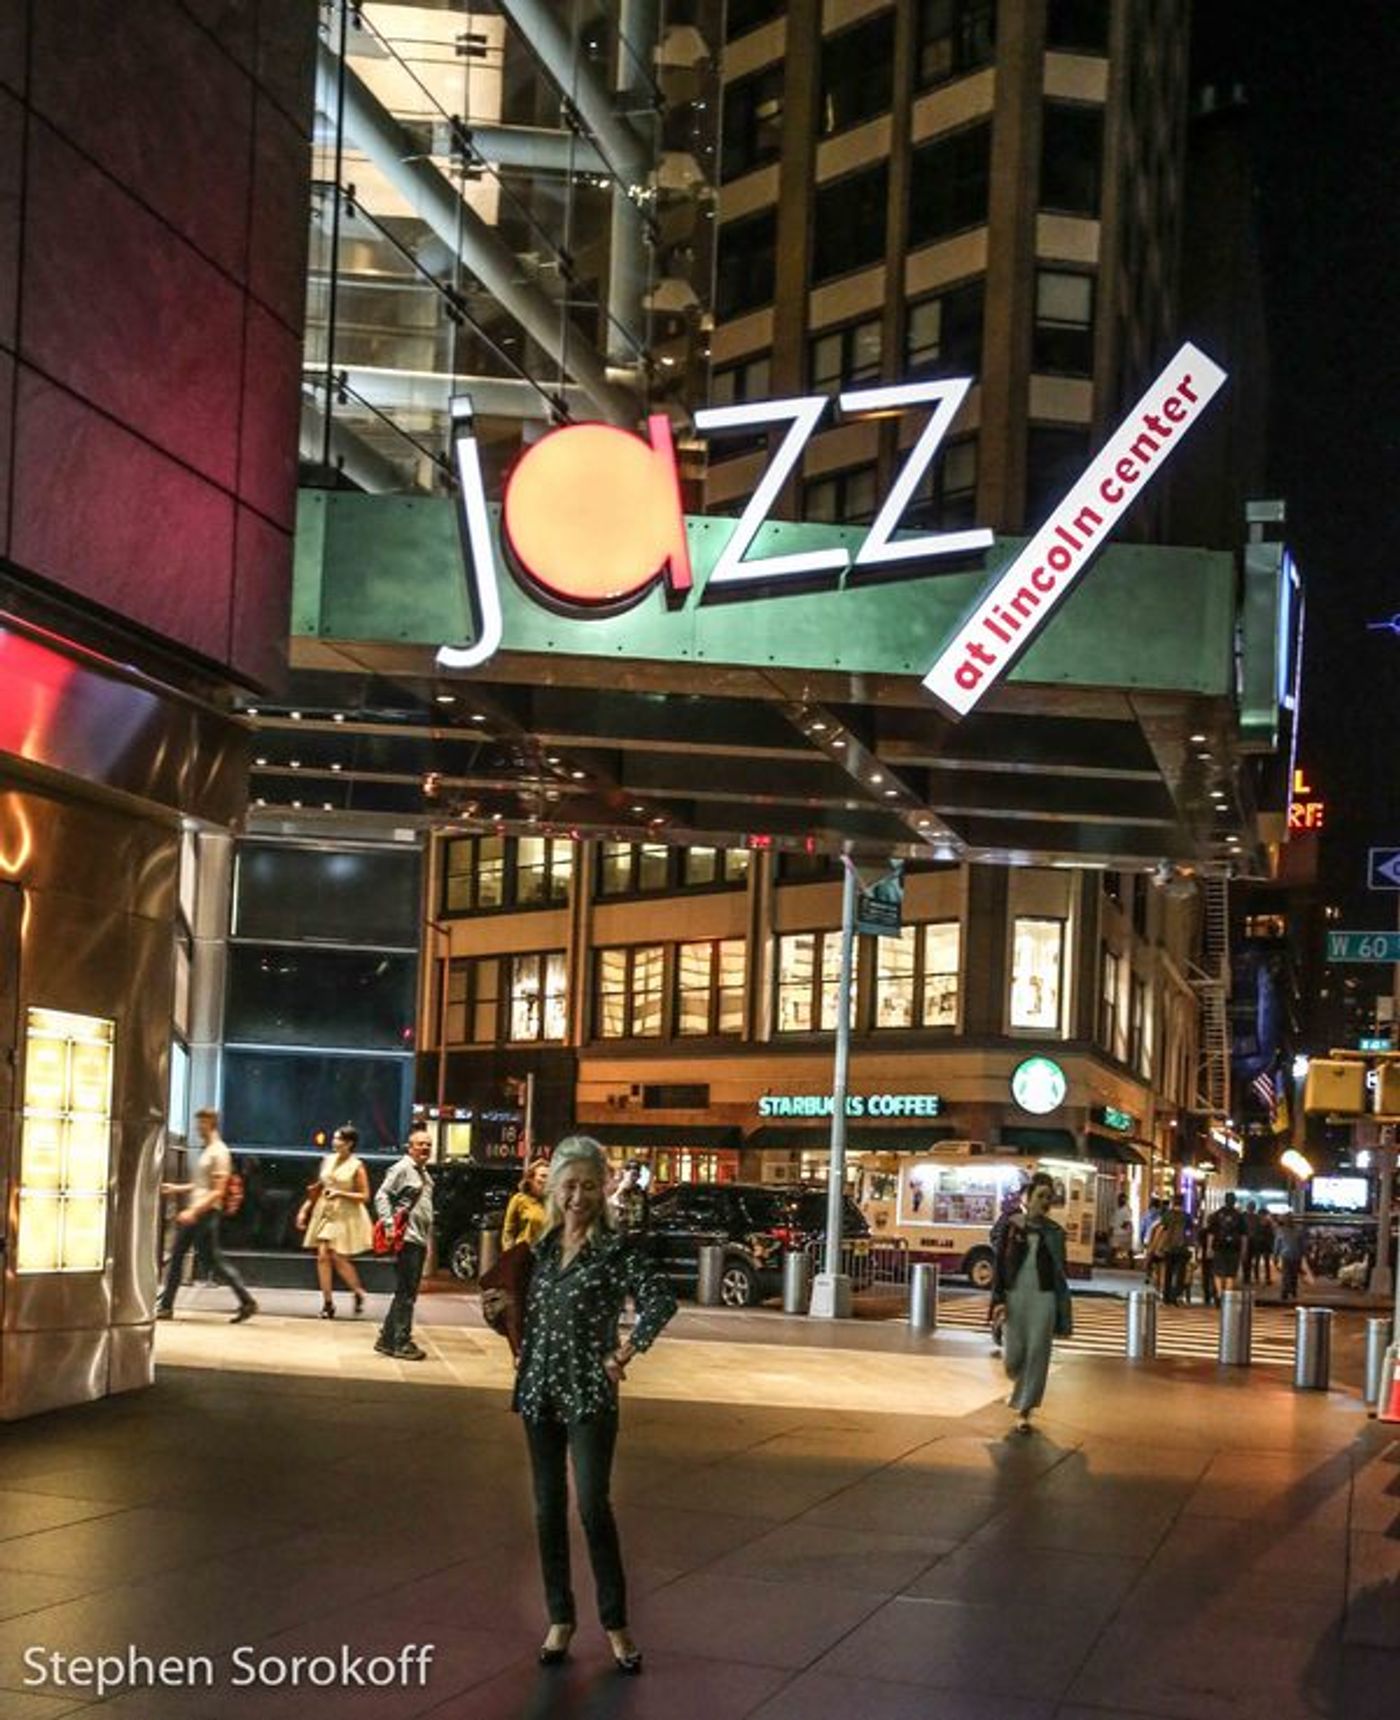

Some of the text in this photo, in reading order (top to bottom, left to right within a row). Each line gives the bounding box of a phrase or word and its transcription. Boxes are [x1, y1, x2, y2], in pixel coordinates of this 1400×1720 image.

[434, 377, 995, 668] jazz
[954, 374, 1199, 691] at lincoln center
[1332, 935, 1350, 956] W
[1358, 936, 1388, 958] 60
[867, 1094, 939, 1116] COFFEE
